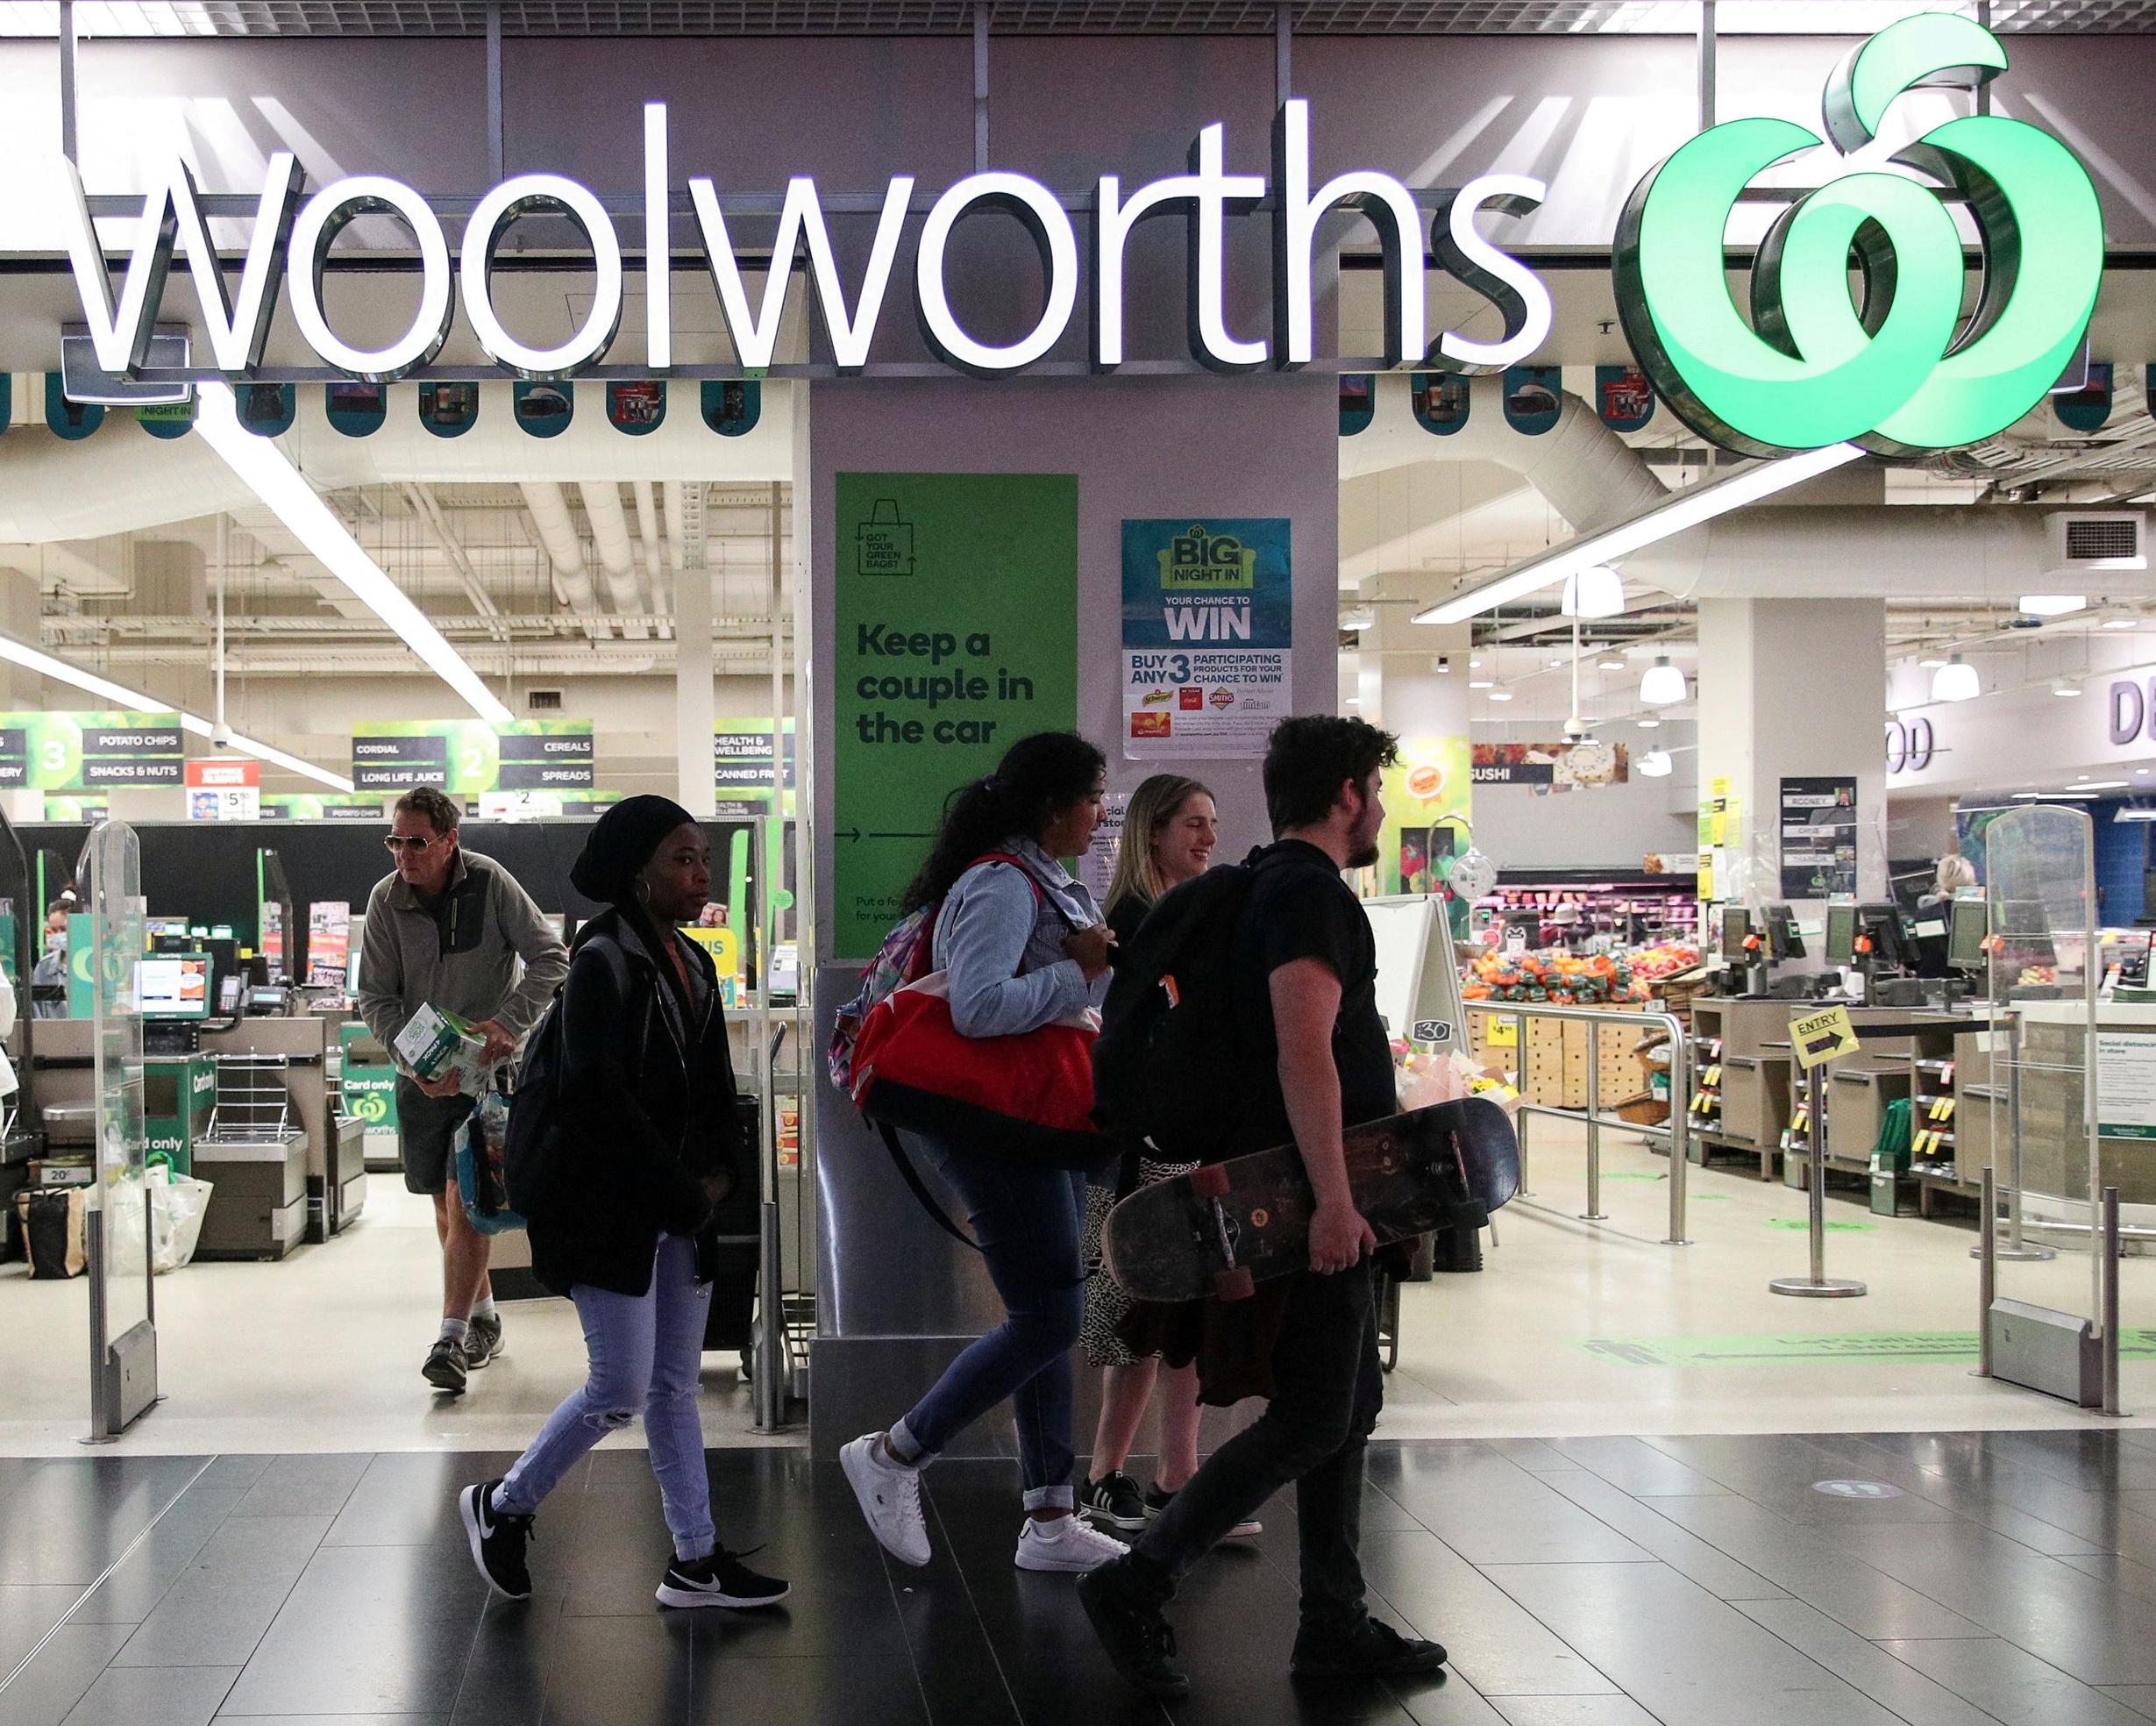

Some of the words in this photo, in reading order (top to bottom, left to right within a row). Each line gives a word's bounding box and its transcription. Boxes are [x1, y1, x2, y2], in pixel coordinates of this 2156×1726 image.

[39, 98, 1554, 373] Woolworths
[144, 406, 178, 416] NIGHT
[181, 406, 191, 416] IN
[865, 533, 887, 542] GOT
[866, 542, 894, 551] YOUR
[866, 551, 901, 560] GREEN
[1174, 538, 1240, 567] BIG
[865, 560, 899, 569] BAGS?
[1174, 568, 1223, 581] NIGHT
[1225, 568, 1240, 581] IN
[1165, 596, 1192, 605] YOUR
[1193, 596, 1235, 605] CHANCE
[1236, 596, 1250, 605] TO
[1163, 607, 1251, 640] WIN
[857, 624, 957, 665] Keep
[964, 632, 991, 656] a
[1131, 655, 1168, 668] BUY
[1193, 654, 1282, 665] PARTICIPATING
[1169, 654, 1192, 684] 3
[1131, 670, 1168, 684] ANY
[1193, 674, 1241, 683] CHANCE
[1242, 674, 1258, 683] TO
[857, 667, 989, 709] couple
[998, 667, 1034, 700] in
[2110, 673, 2156, 746] D
[856, 711, 925, 744] the
[933, 719, 997, 744] car
[98, 736, 142, 746] POTATO
[144, 735, 178, 746] CHIPS
[715, 737, 755, 745] HEALTH
[756, 737, 765, 745] &
[356, 745, 400, 754] CORDIAL
[544, 742, 591, 752] CEREALS
[715, 746, 772, 755] WELLBEING
[42, 740, 67, 771] 3
[462, 750, 483, 778] 2
[89, 767, 135, 777] SNACKS
[136, 767, 145, 776] &
[146, 766, 178, 776] NUTS
[542, 770, 591, 781] SPREADS
[715, 770, 758, 780] CANNED
[361, 773, 392, 783] LONG
[392, 773, 413, 782] LIFE
[415, 772, 445, 782] JUICE
[856, 896, 876, 906] Put
[856, 911, 871, 921] for
[873, 913, 896, 924] your
[1797, 1012, 1838, 1034] ENTRY
[343, 1079, 371, 1090] Card
[371, 1079, 395, 1092] only
[151, 1137, 183, 1152] only
